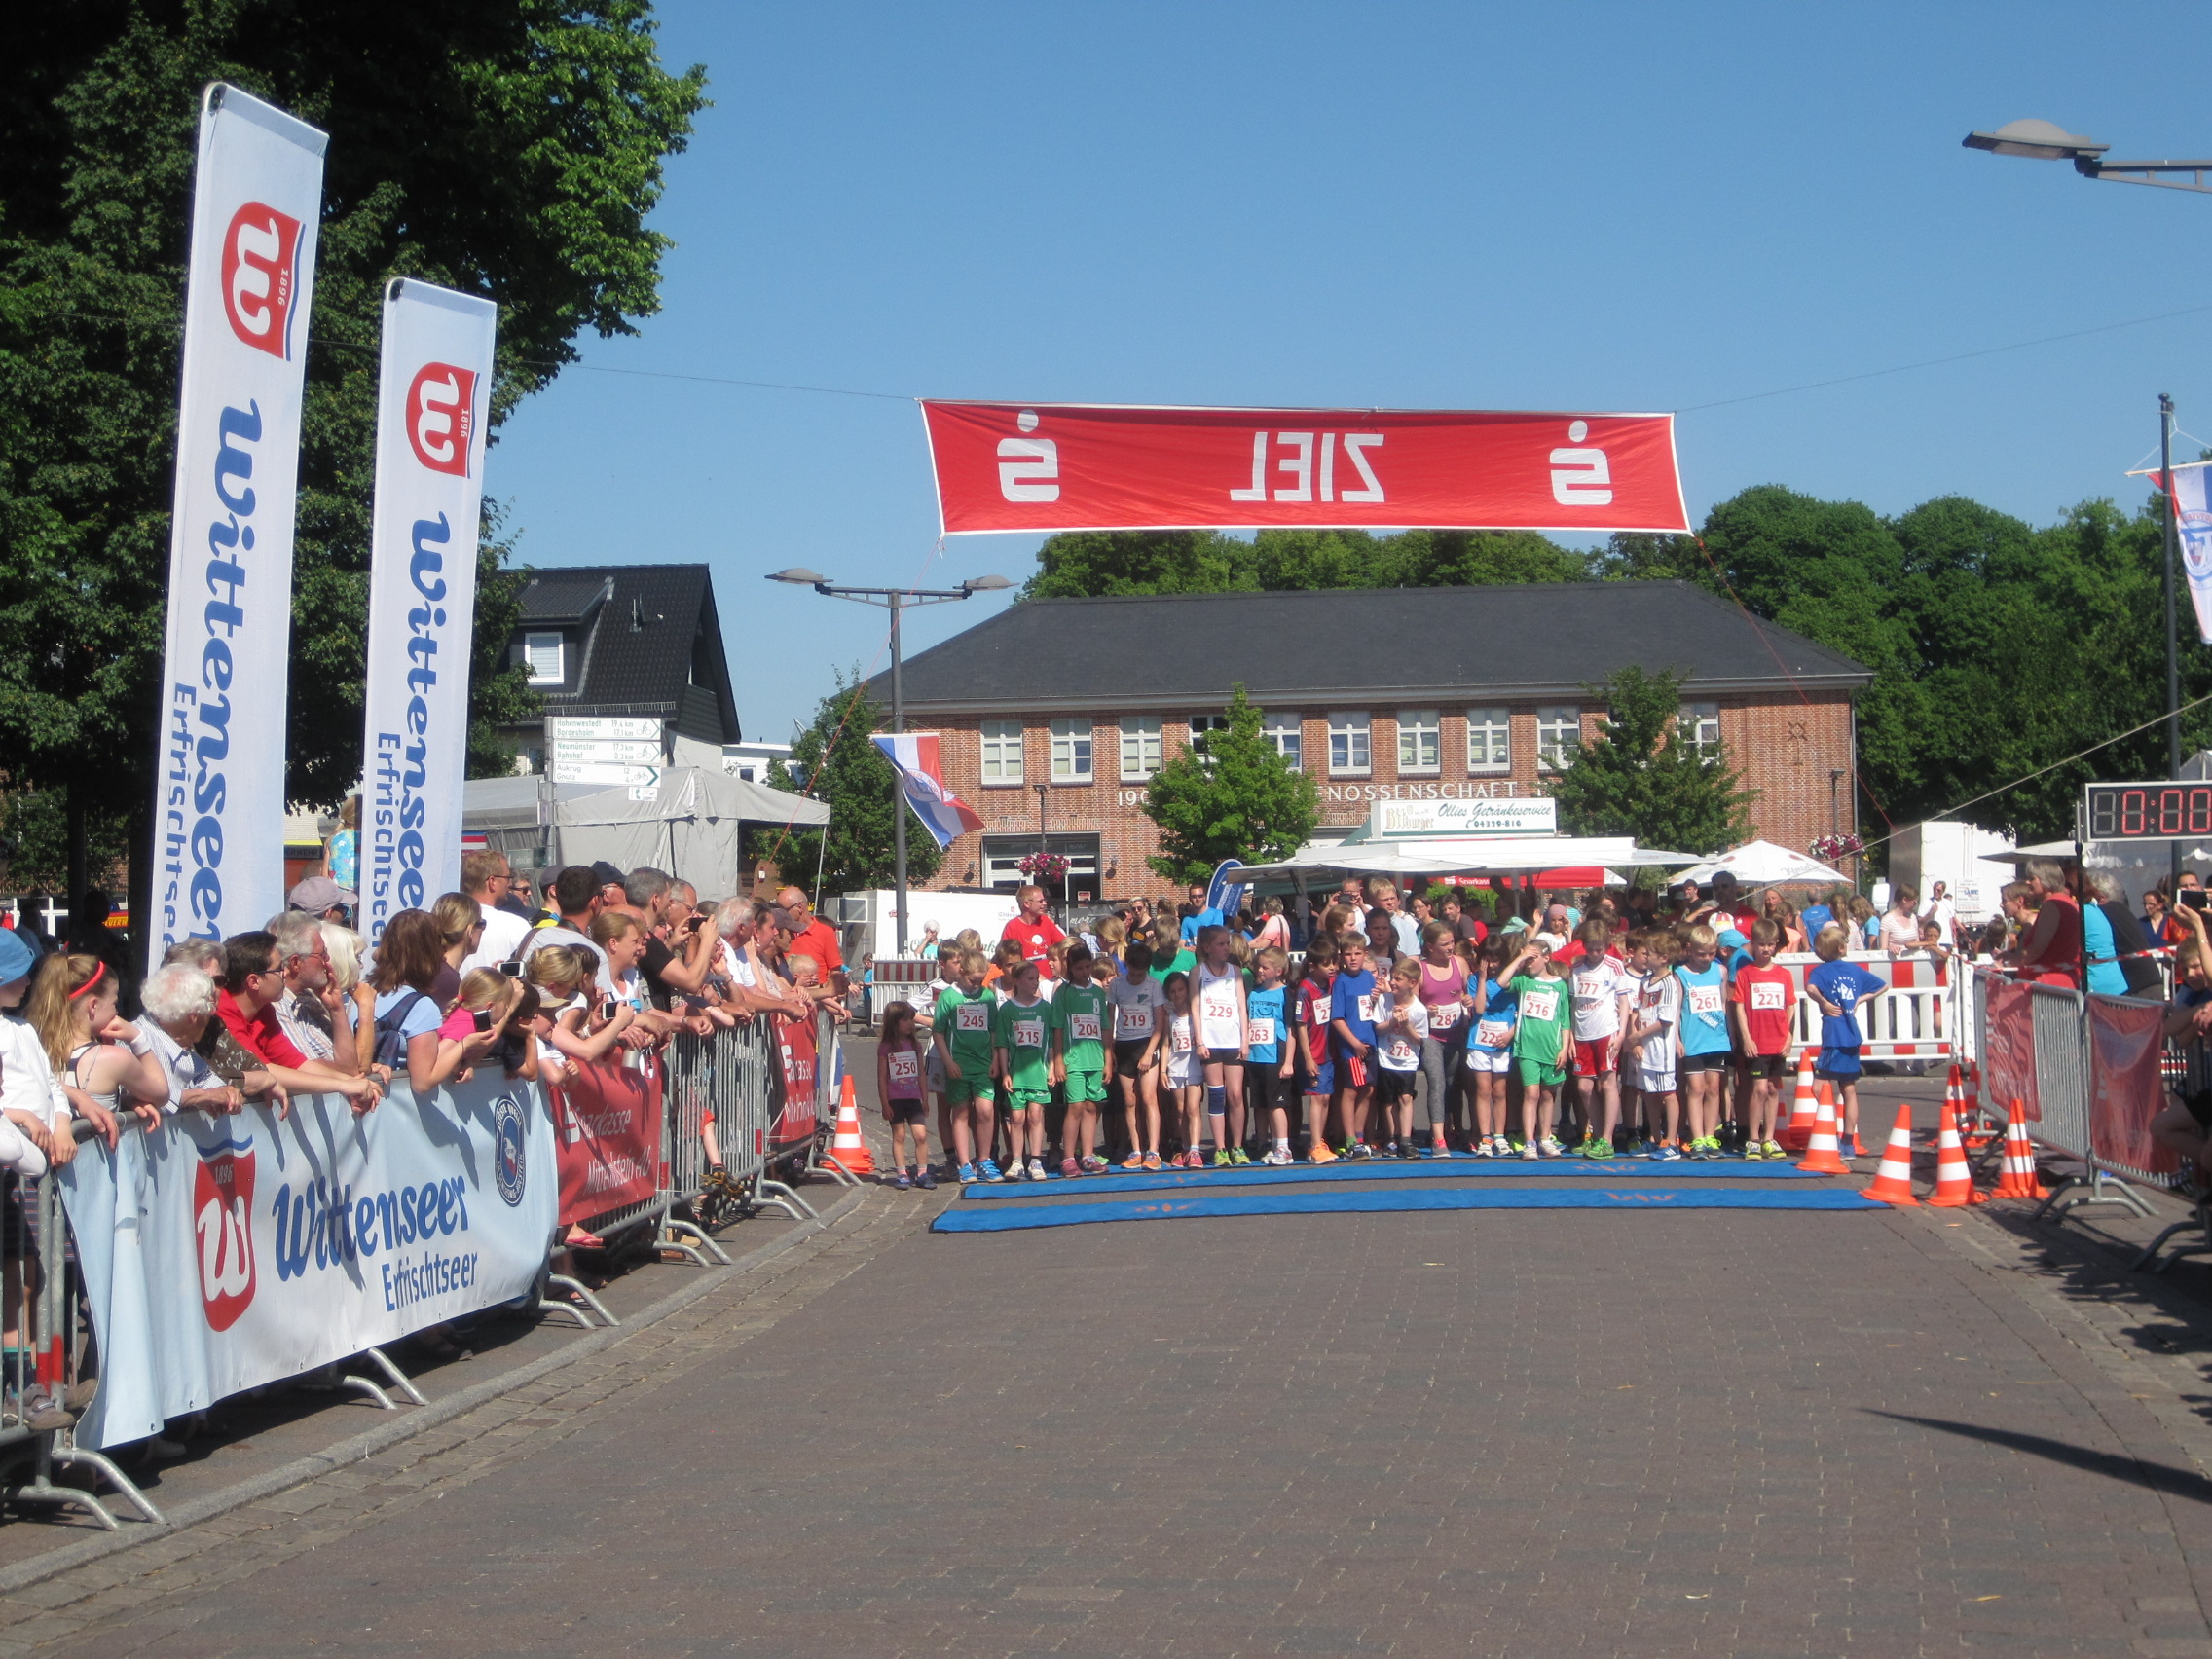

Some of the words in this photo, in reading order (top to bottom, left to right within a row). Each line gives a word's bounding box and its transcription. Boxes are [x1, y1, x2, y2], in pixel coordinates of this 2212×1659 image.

[277, 268, 289, 306] 1896
[460, 409, 469, 438] 1896
[397, 511, 450, 909] Wittensee
[557, 764, 581, 773] Aukrug
[1438, 802, 1467, 817] Ollies
[1471, 802, 1552, 820] Getränkeservice
[1578, 983, 1599, 995] 277
[1696, 996, 1717, 1010] 261
[1758, 993, 1781, 1006] 221
[1208, 1005, 1233, 1018] 229
[1526, 1002, 1550, 1017] 216
[962, 1015, 984, 1028] 245
[1123, 1014, 1146, 1027] 219
[1017, 1031, 1039, 1044] 215
[1078, 1024, 1099, 1037] 204
[1249, 1029, 1269, 1042] 263
[1480, 1031, 1496, 1045] 22
[1389, 1046, 1411, 1057] 278
[895, 1062, 916, 1076] 250
[214, 1164, 234, 1186] 1896
[272, 1175, 469, 1282] Wittenseer
[381, 1251, 478, 1313] Erfrischtseer
